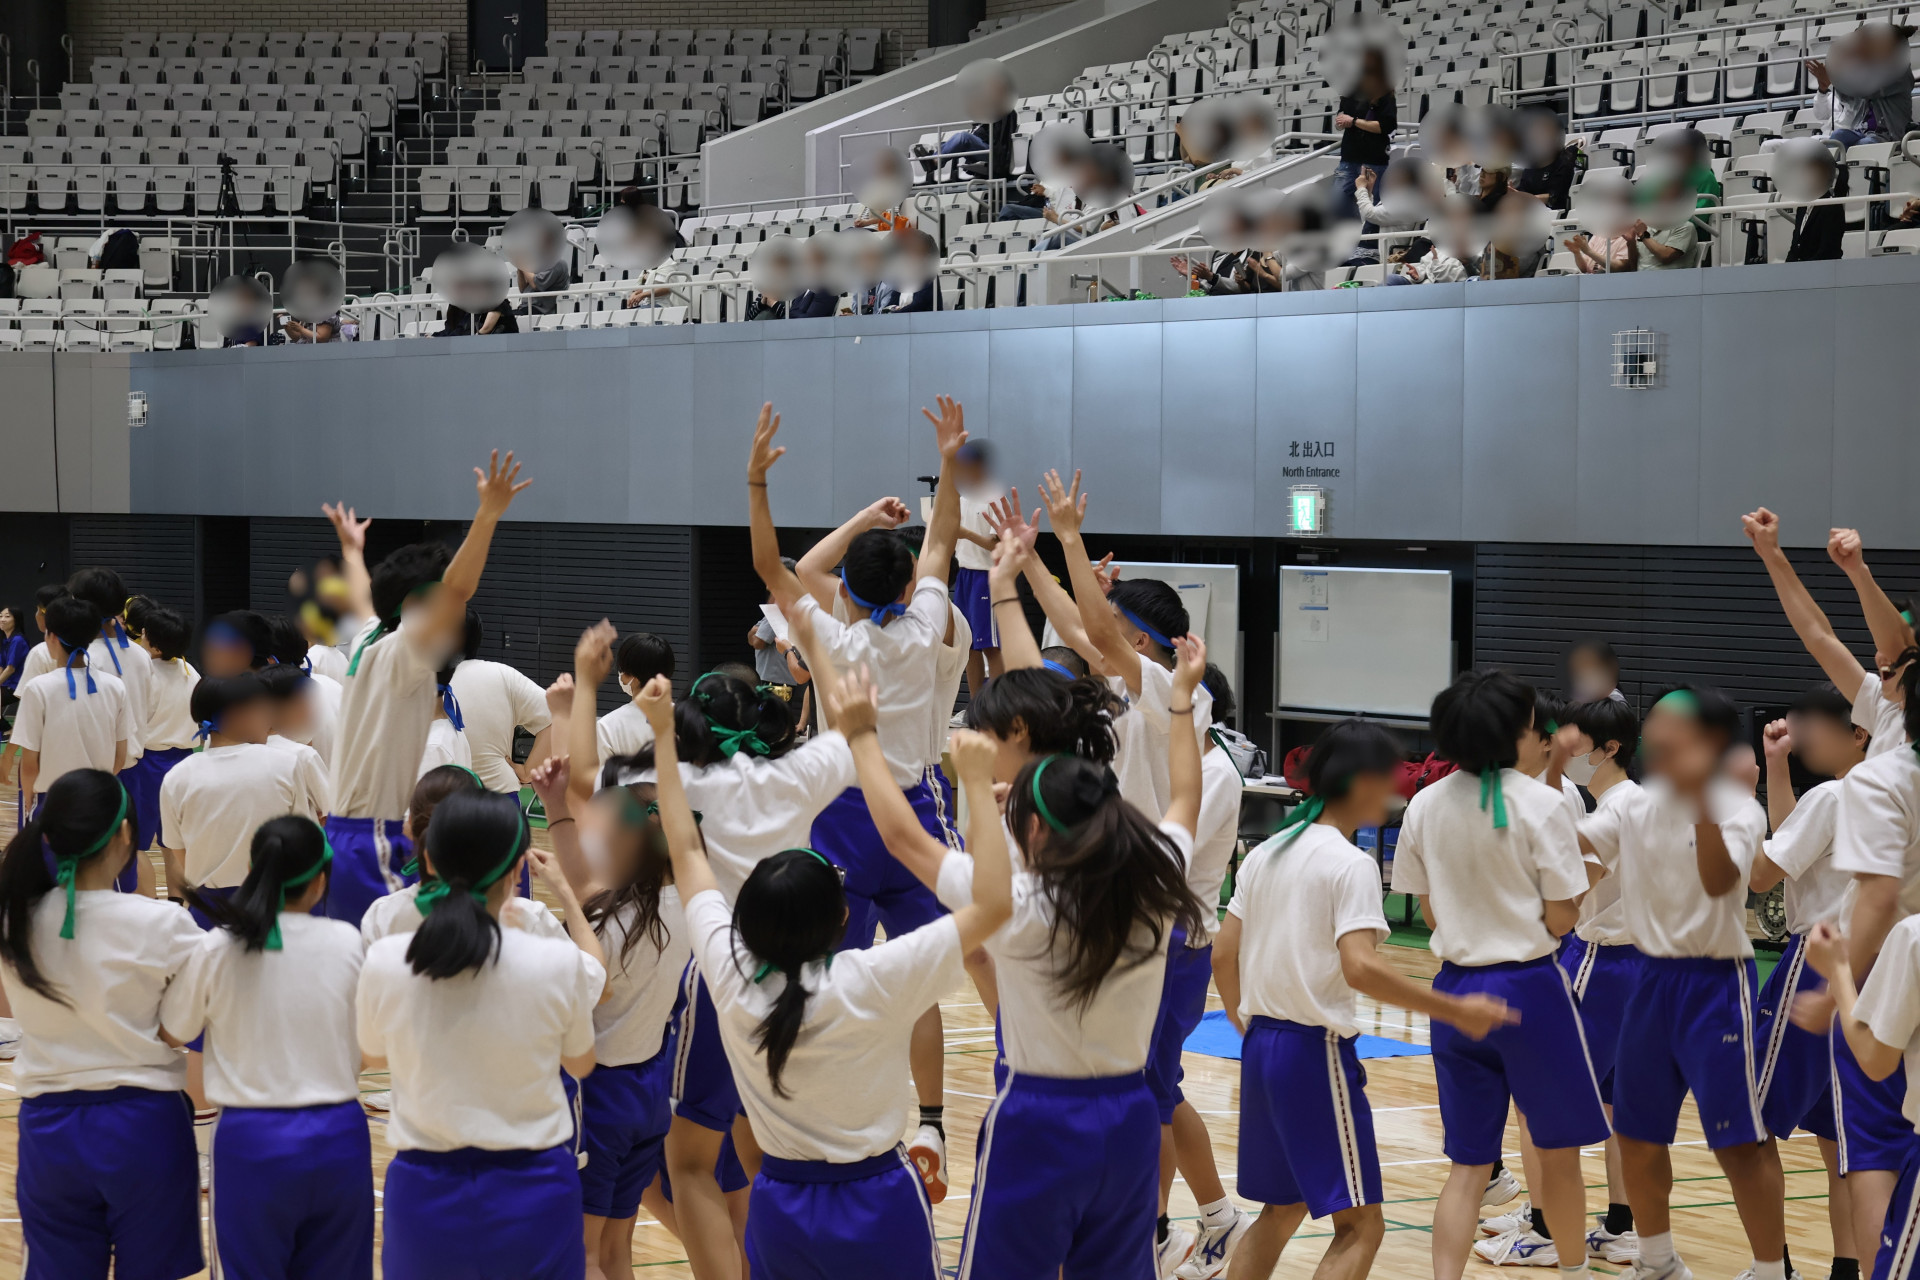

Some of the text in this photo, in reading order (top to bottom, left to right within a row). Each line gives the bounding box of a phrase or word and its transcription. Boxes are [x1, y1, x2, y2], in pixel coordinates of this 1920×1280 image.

[1289, 441, 1334, 457] 北 出入口
[1282, 466, 1340, 477] North Entrance
